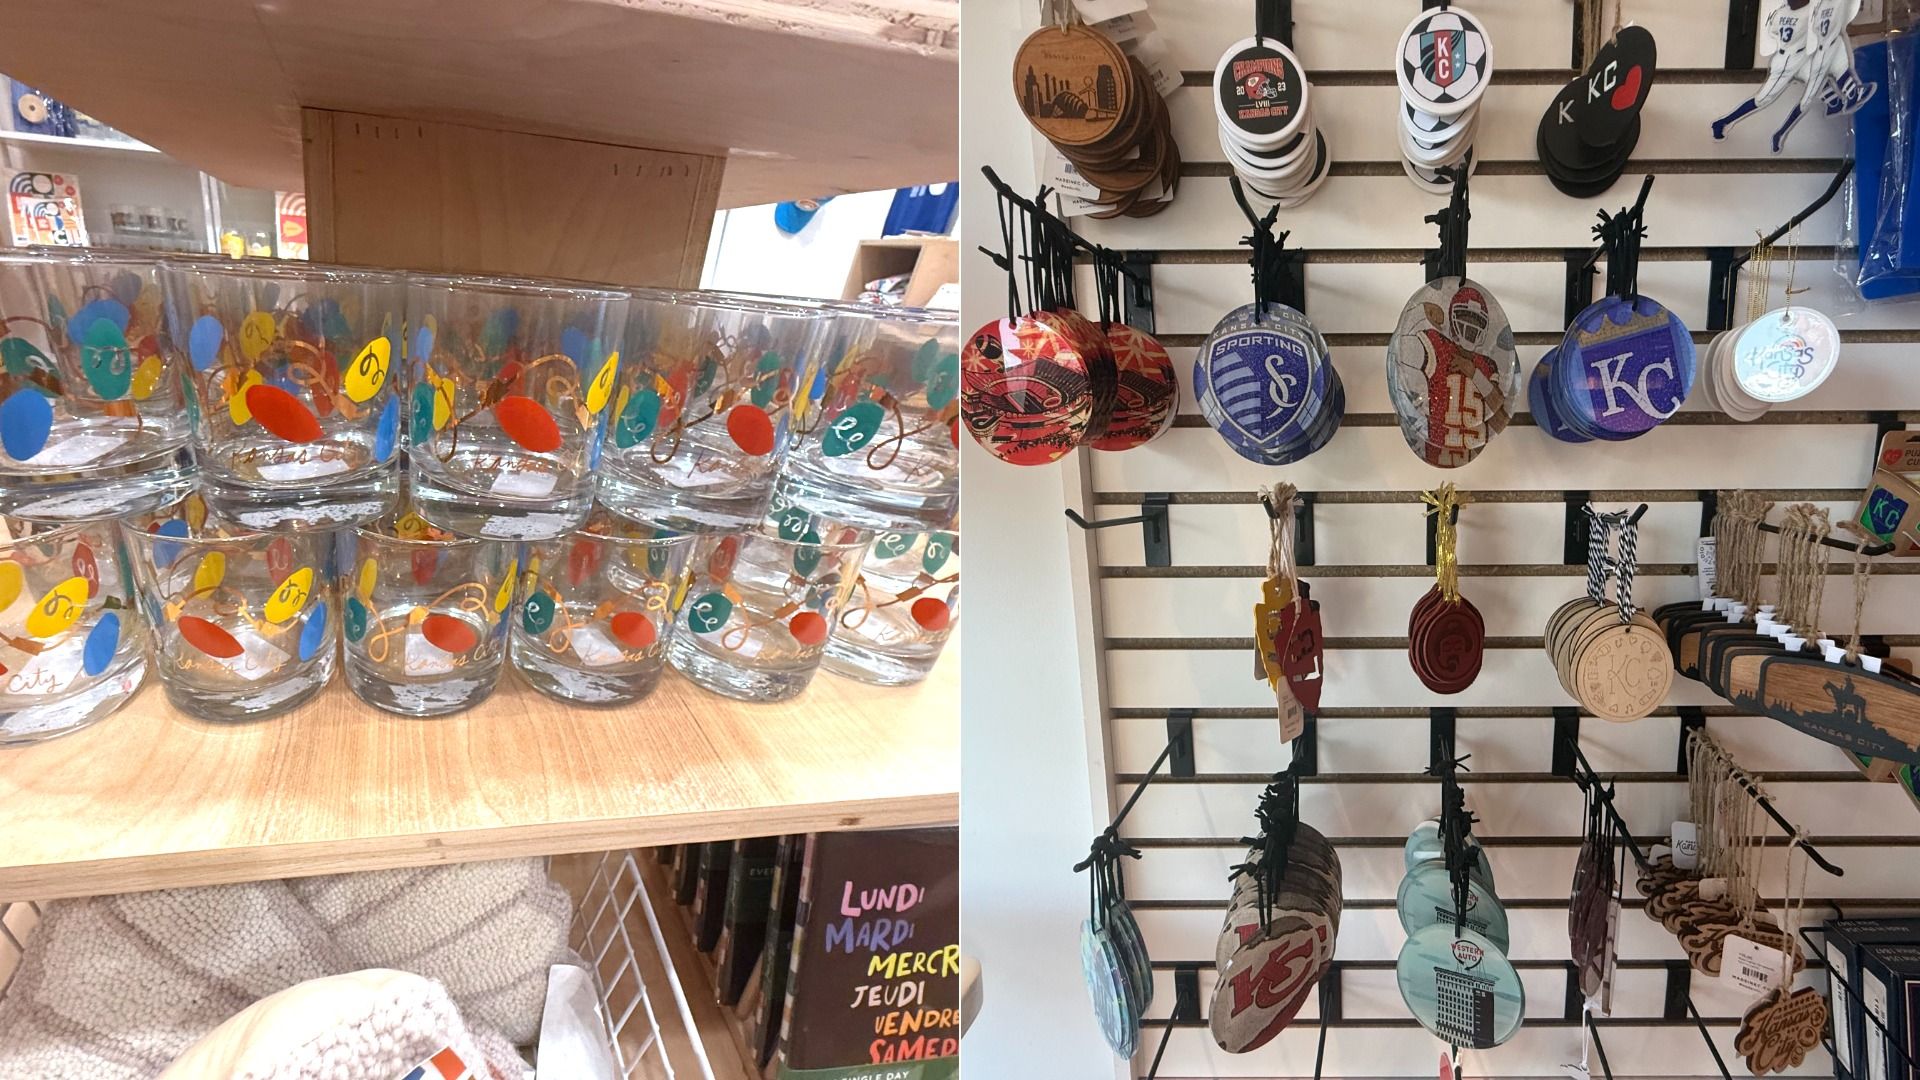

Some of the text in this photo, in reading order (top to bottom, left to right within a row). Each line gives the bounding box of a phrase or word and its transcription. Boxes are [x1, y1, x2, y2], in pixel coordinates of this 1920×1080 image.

[1780, 17, 1799, 26] PEREZ
[1821, 19, 1830, 37] 13
[1780, 27, 1794, 42] 13
[1233, 57, 1284, 82] CHAMPIONS
[1588, 60, 1617, 104] KC
[1236, 86, 1245, 96] 20
[1277, 82, 1286, 92] 23
[1238, 105, 1288, 119] KANSAS CITY
[1255, 100, 1270, 108] LVIII
[1212, 322, 1306, 339] KANSAS CITY
[1215, 336, 1304, 358] SPORTING
[1590, 351, 1682, 419] KC
[1444, 373, 1485, 428] 15
[1873, 498, 1900, 530] KC
[8, 668, 64, 693] City
[1803, 721, 1886, 752] KANSAS CITY
[840, 880, 925, 917] LUNDI
[825, 917, 915, 954] MARDI
[867, 943, 959, 979] MERCR
[1451, 943, 1484, 958] WESTERN
[1457, 952, 1477, 962] AUTO
[850, 980, 925, 1008] JEUDI
[869, 1035, 959, 1066] SAMED
